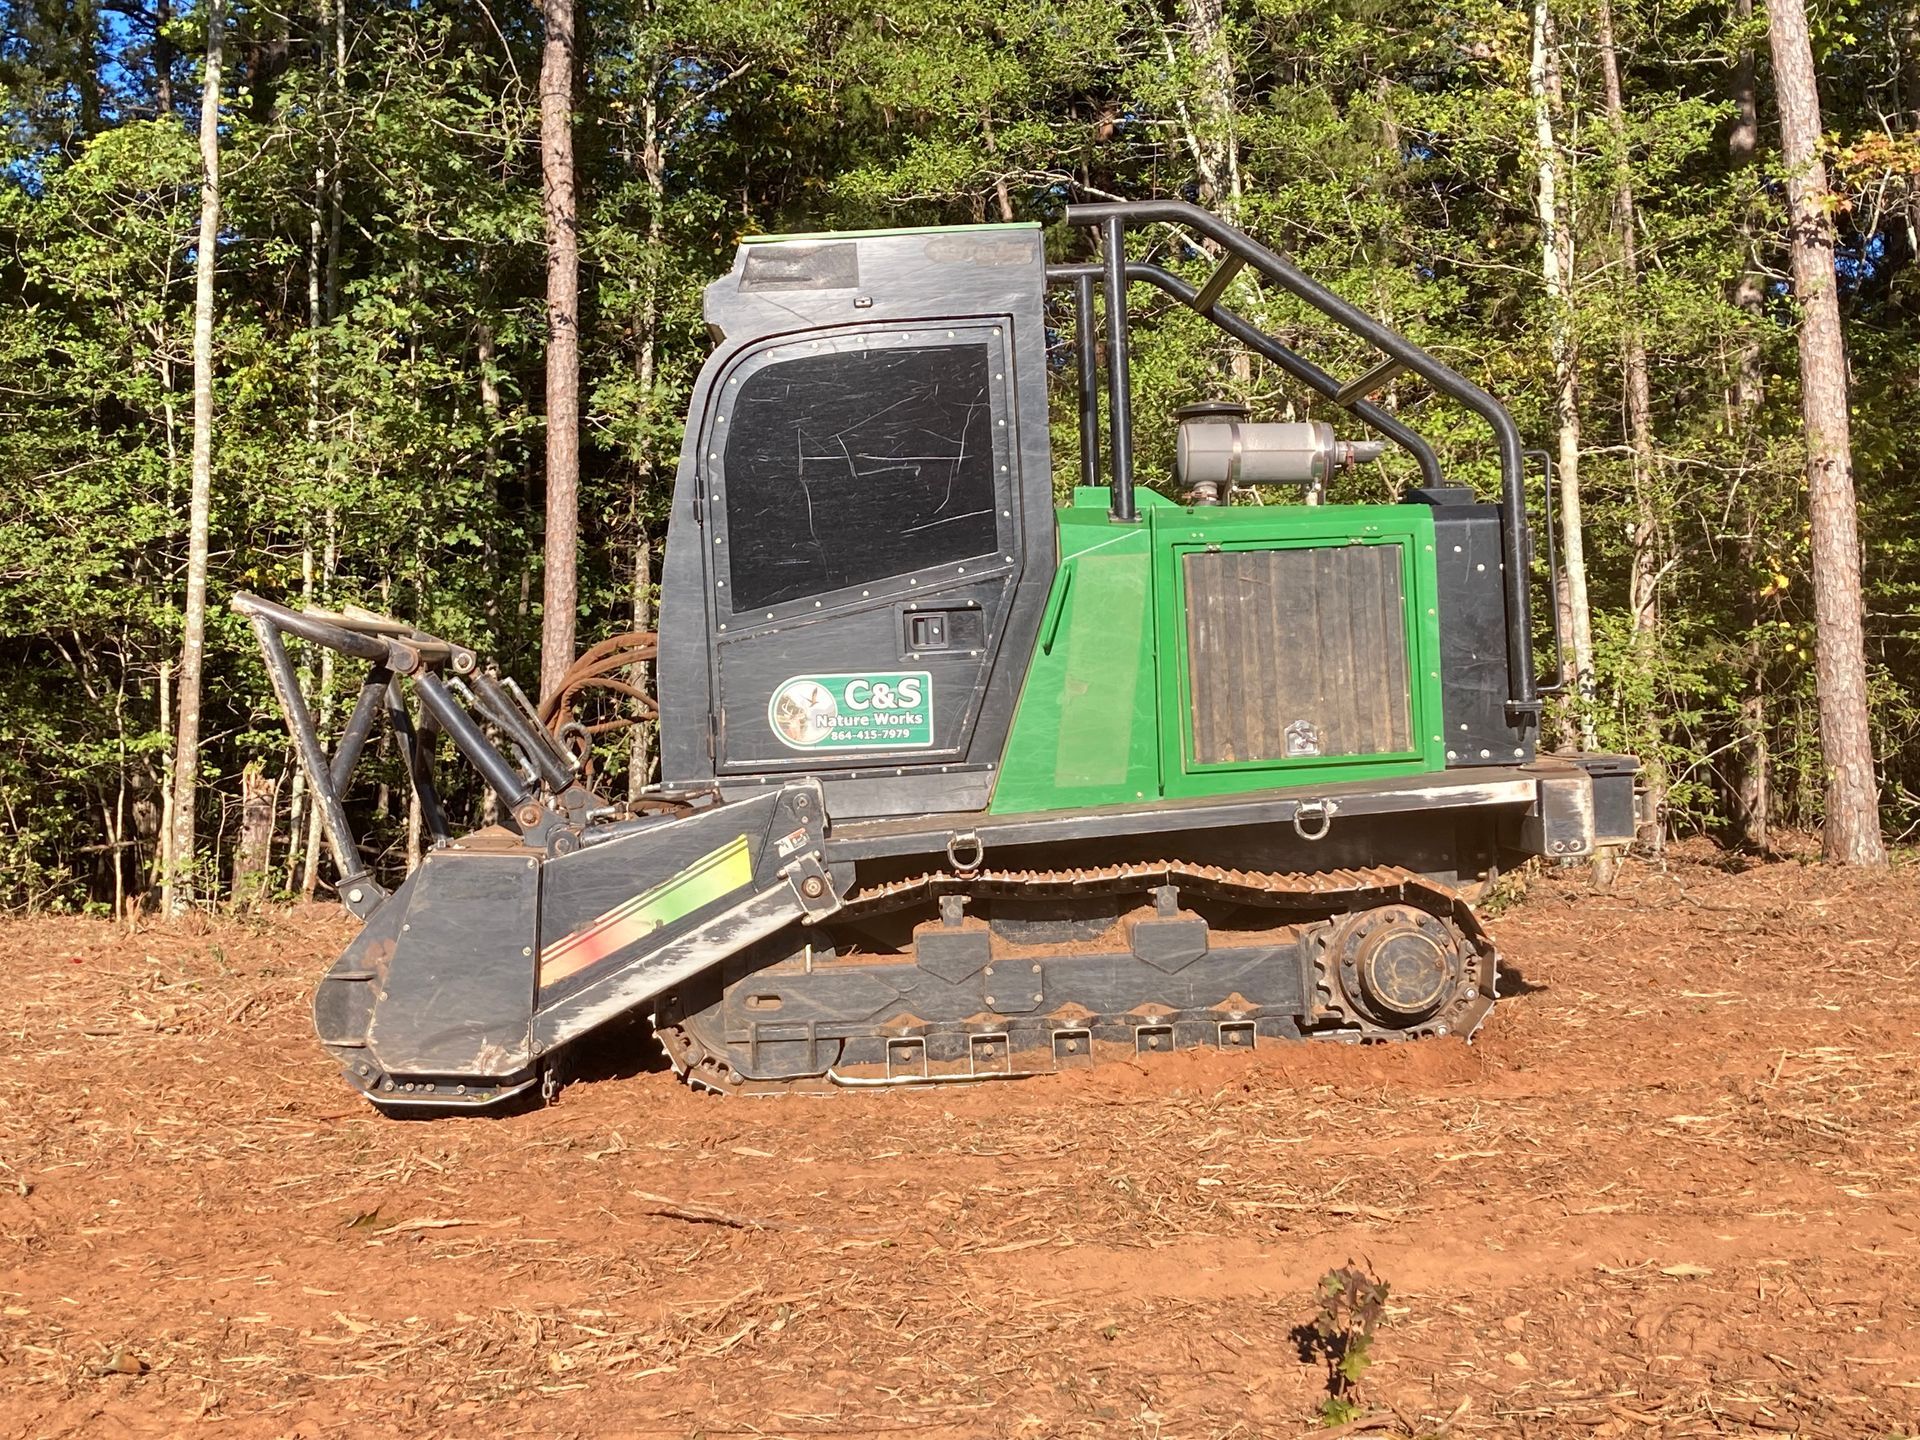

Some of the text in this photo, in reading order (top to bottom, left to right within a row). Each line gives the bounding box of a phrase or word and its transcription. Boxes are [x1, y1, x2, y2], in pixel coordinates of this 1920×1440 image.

[844, 678, 922, 710] C&S
[816, 712, 923, 727] Nature Works
[830, 729, 910, 741] 864-415-7979
